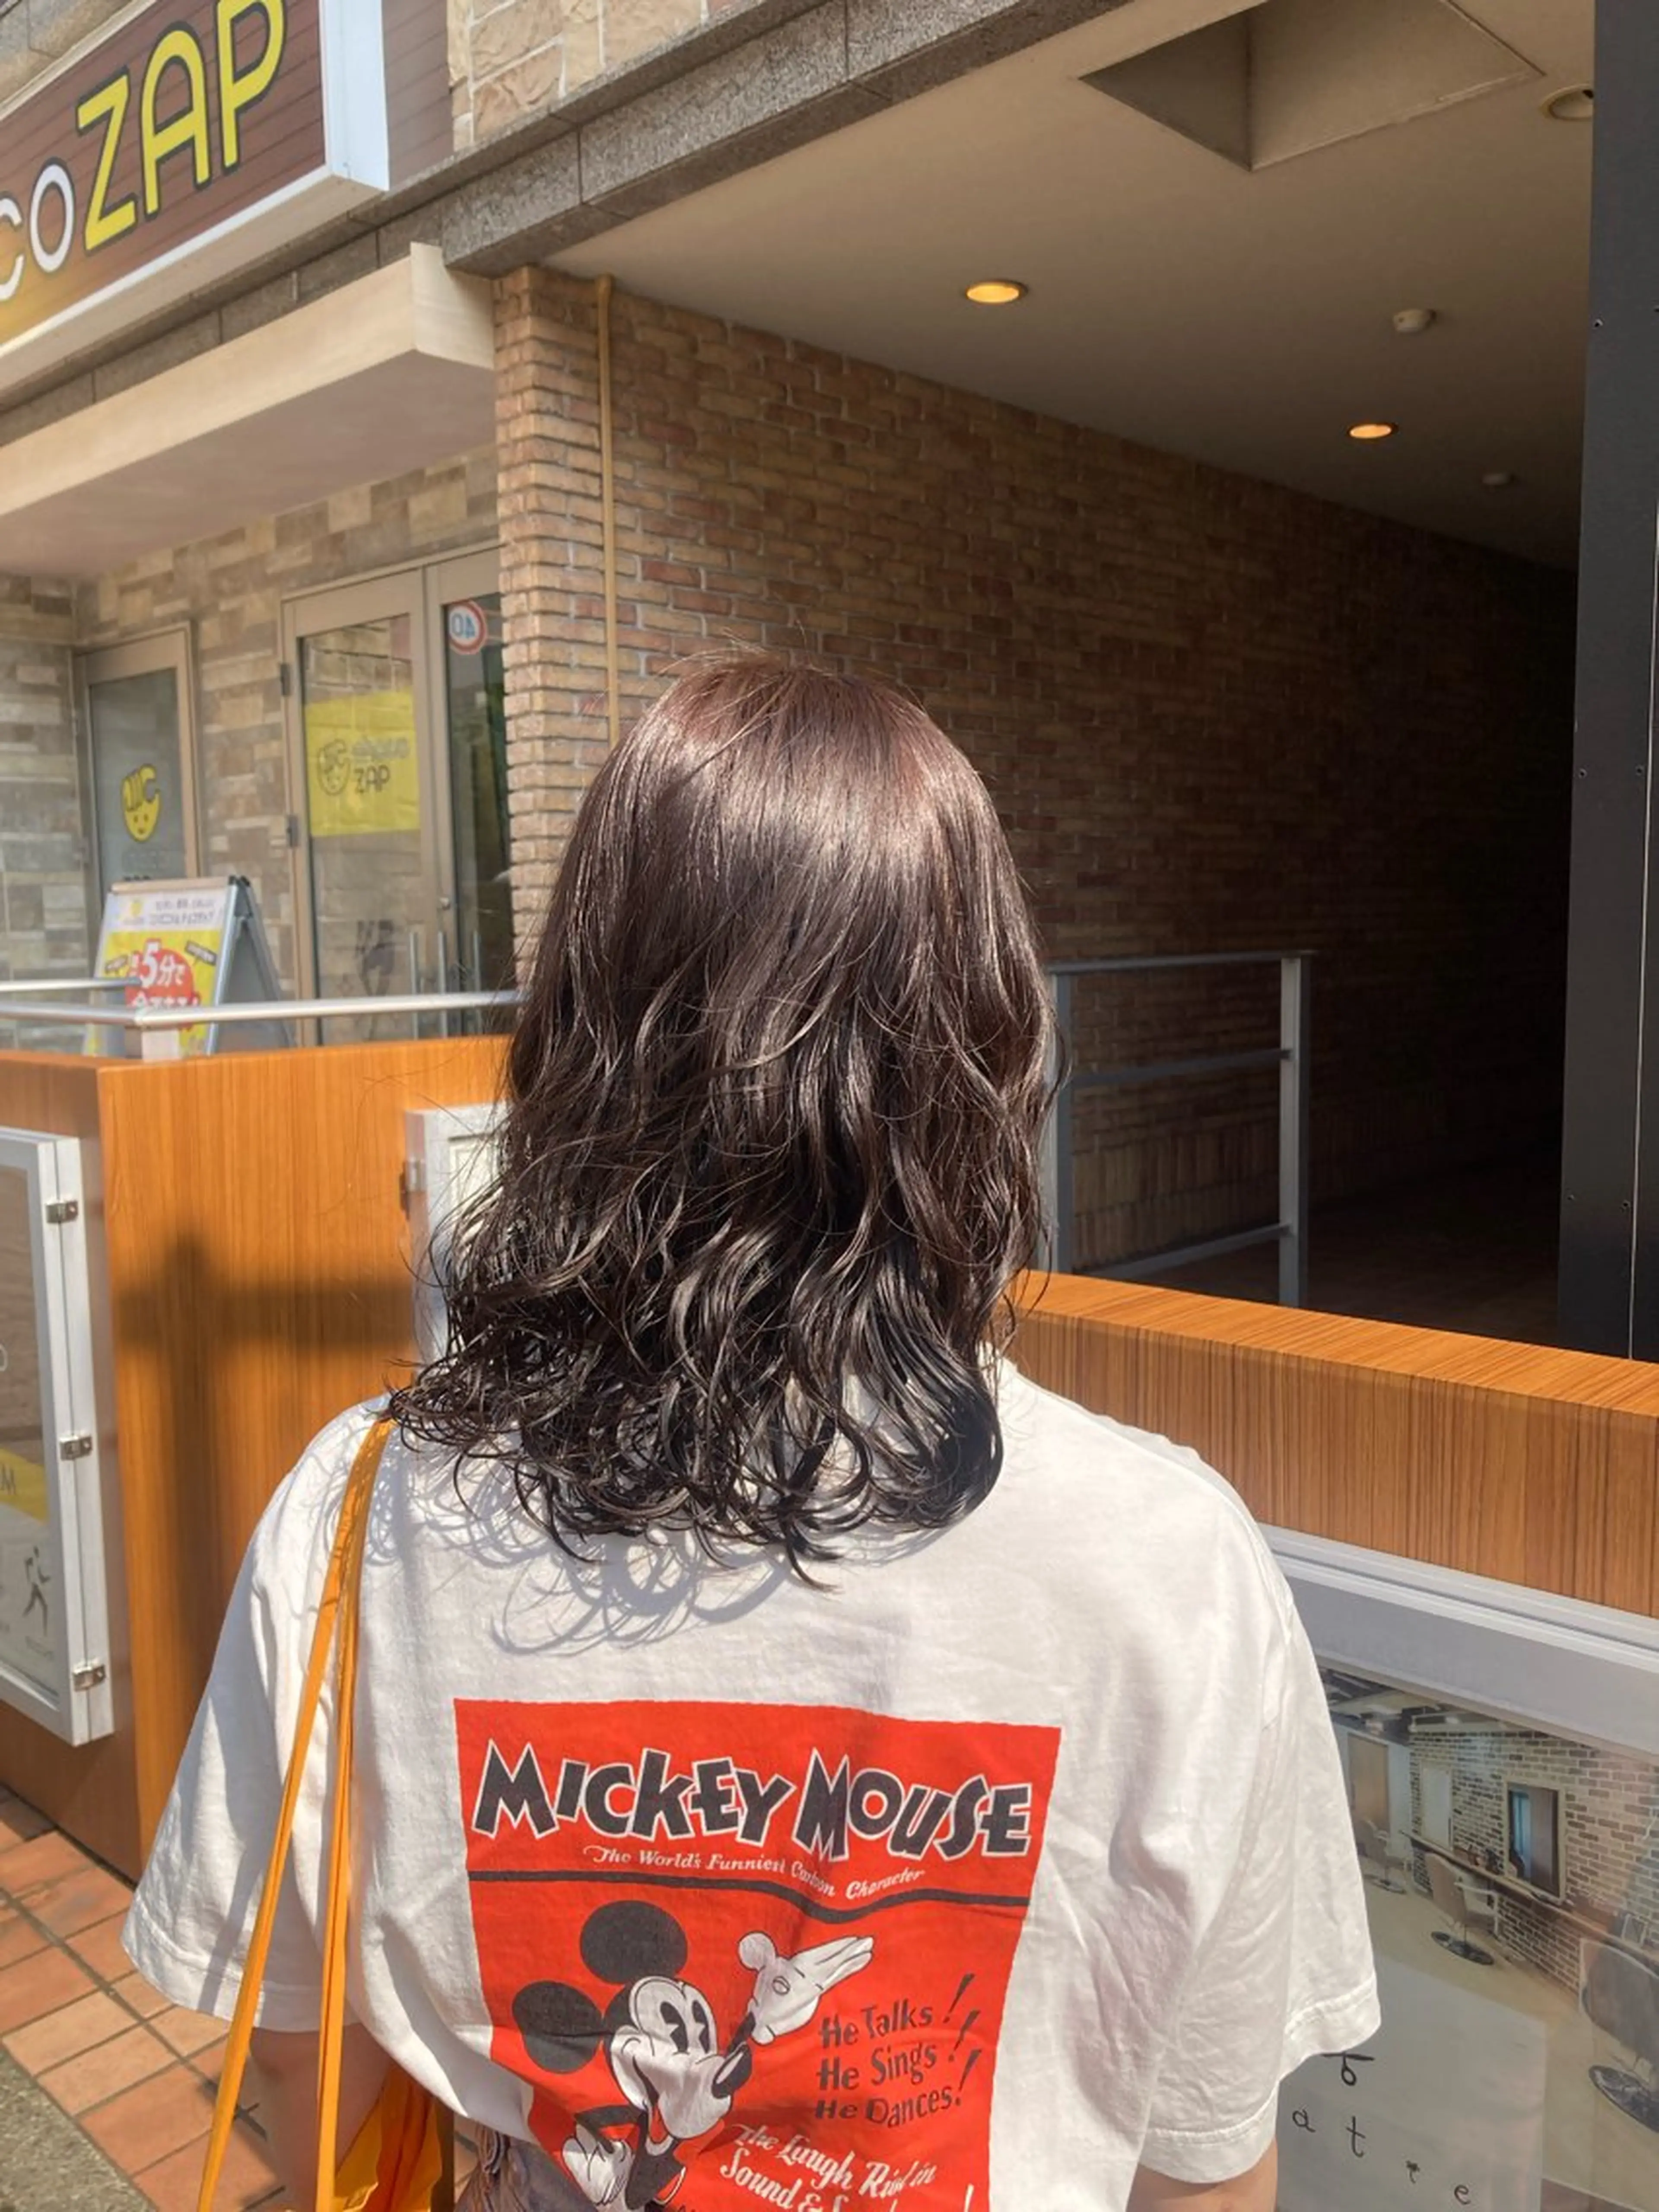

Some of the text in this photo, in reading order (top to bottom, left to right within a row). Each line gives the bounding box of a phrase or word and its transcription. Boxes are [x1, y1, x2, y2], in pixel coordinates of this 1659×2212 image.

[471, 1738, 1032, 1862] MICKEY MOUSE
[583, 1845, 631, 1864] The
[639, 1850, 701, 1869] World's
[845, 1867, 925, 1900] Character
[818, 2014, 859, 2049] He
[816, 2056, 859, 2091] He
[815, 2099, 858, 2119] He
[720, 2147, 803, 2210] Sound
[731, 2123, 780, 2151] The
[776, 2134, 854, 2190] Laugh
